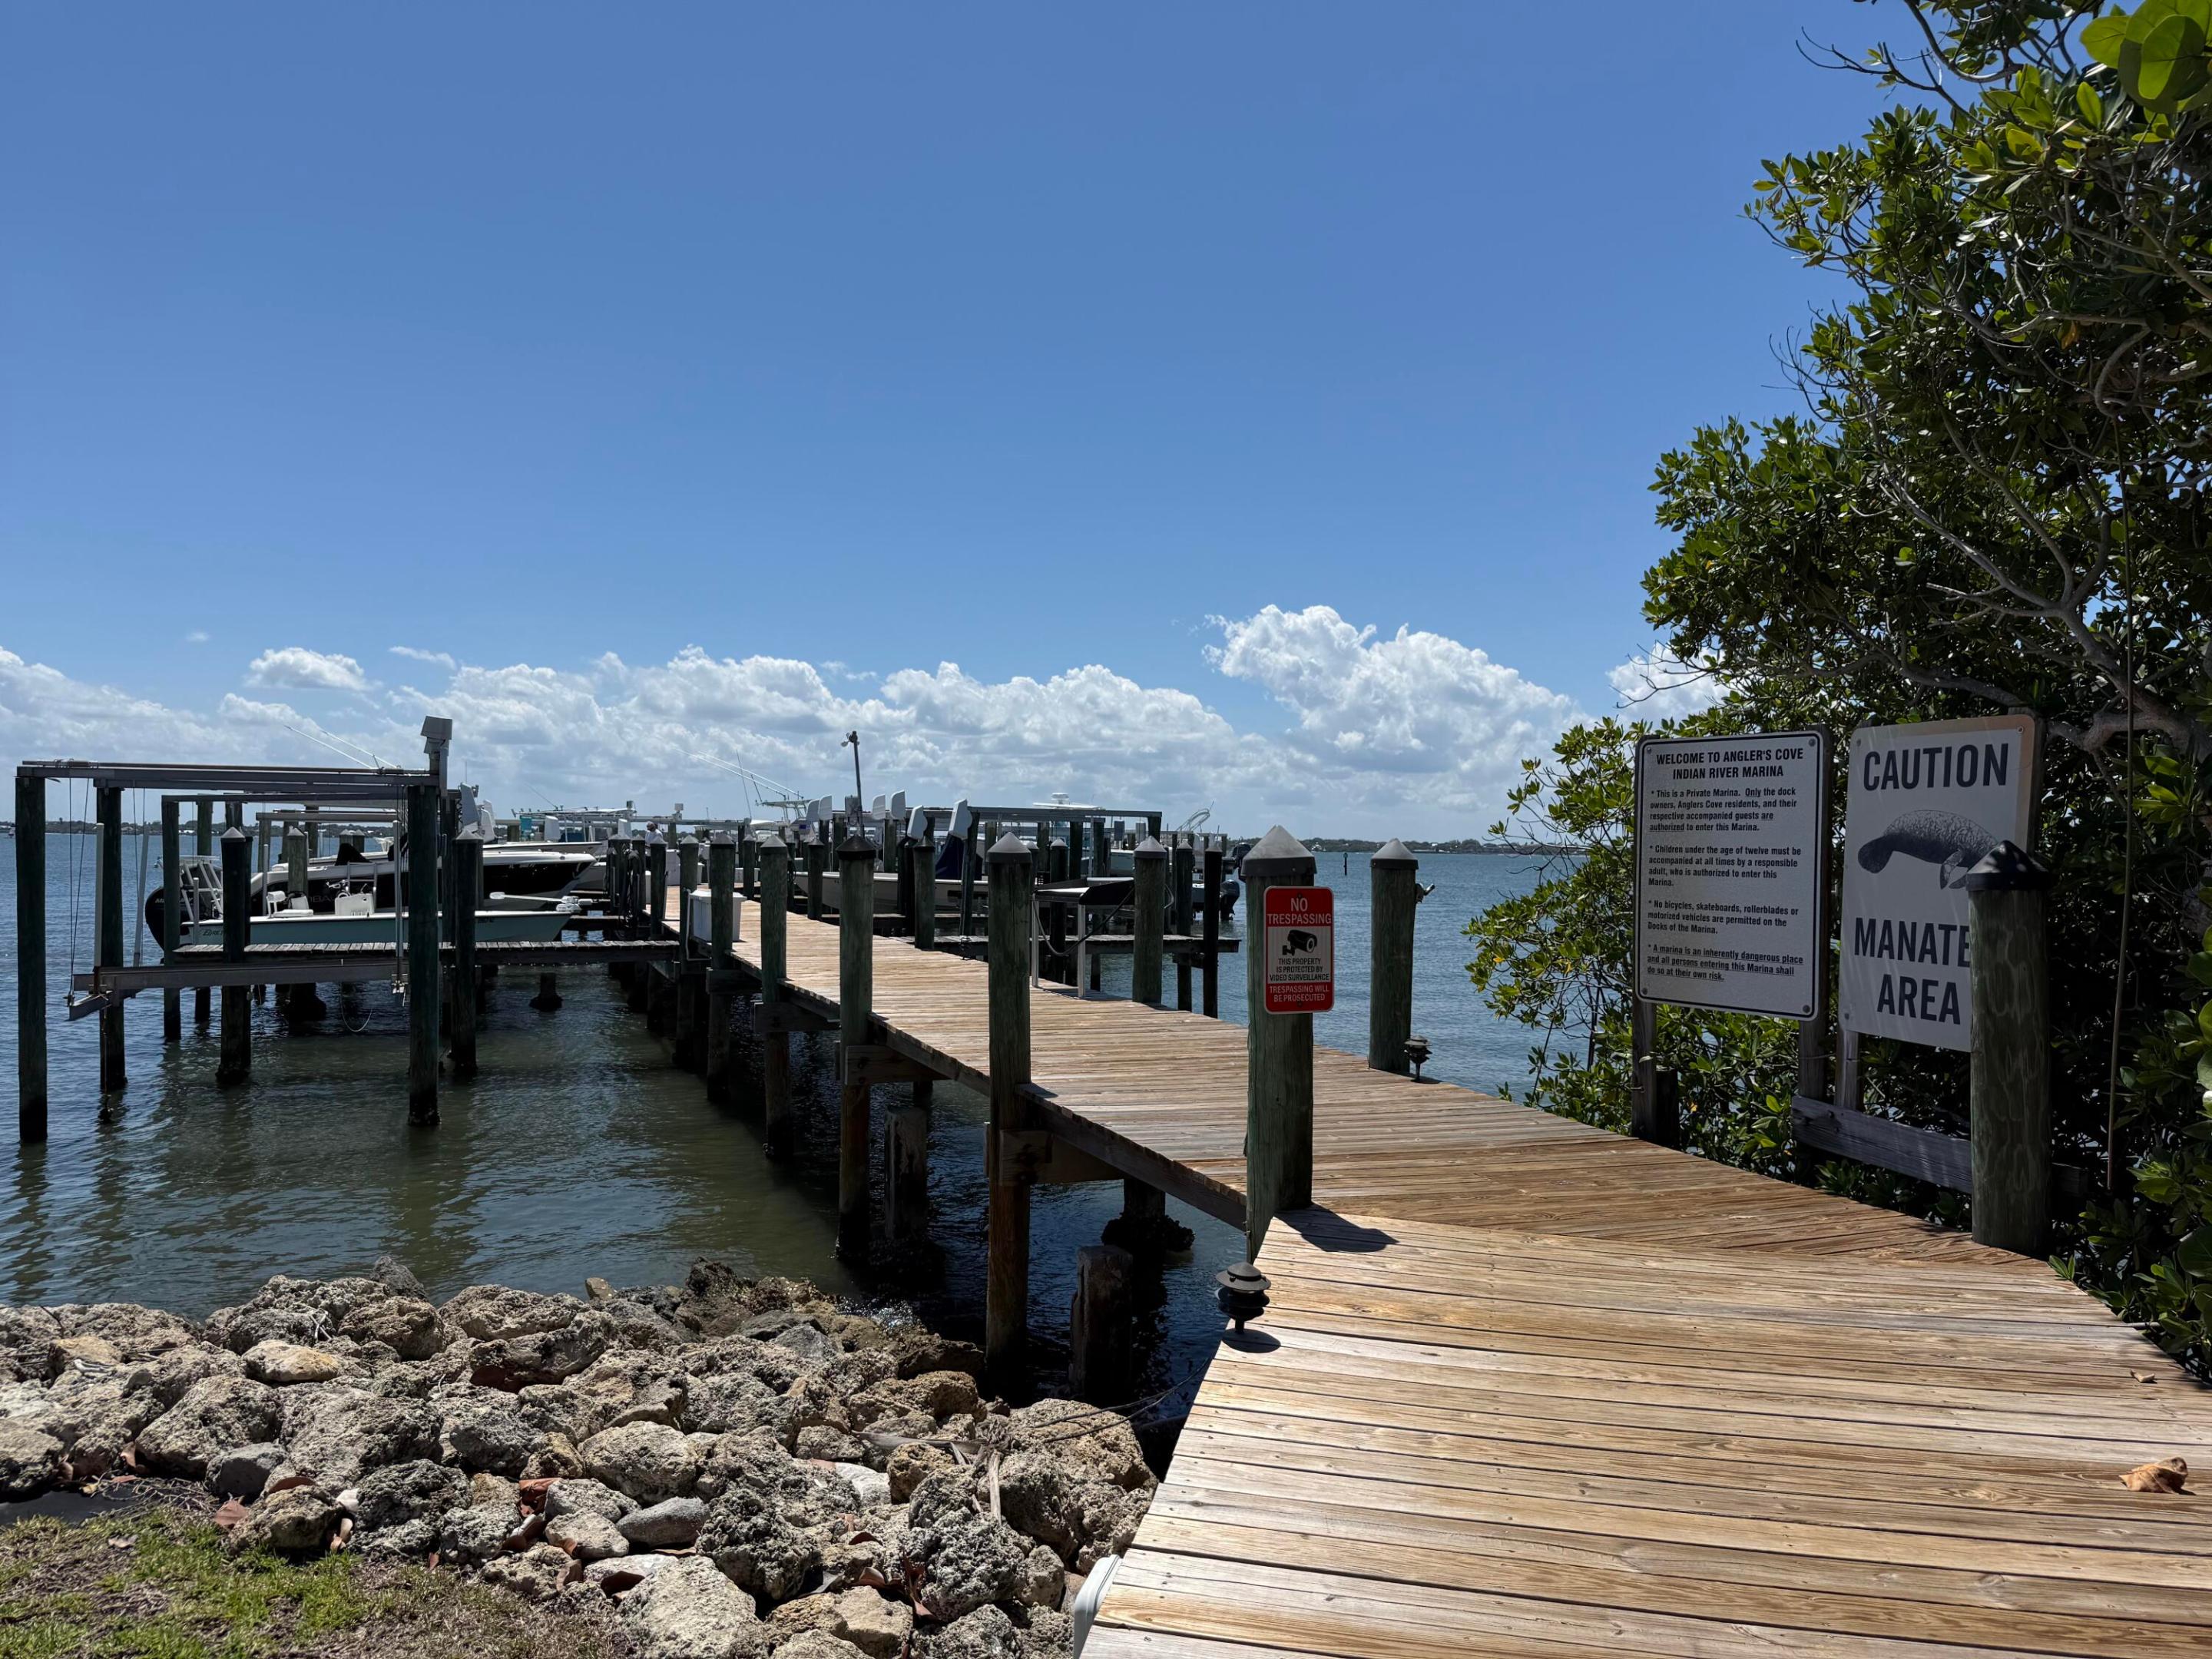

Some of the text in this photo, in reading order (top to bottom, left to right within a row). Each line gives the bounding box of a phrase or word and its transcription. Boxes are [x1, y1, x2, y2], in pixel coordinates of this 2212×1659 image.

[1657, 748, 1803, 764] WELCOME TO ANGLER'S COVE
[1673, 766, 1783, 780] INDIAN RIVER MARINA
[1864, 743, 2008, 791] CAUTION
[1745, 788, 1761, 798] Only
[1778, 787, 1795, 796] dock
[1678, 800, 1704, 810] Anglers
[1725, 800, 1760, 809] residents,
[1651, 812, 1684, 821] respective
[1686, 812, 1732, 821] accompanied
[1736, 812, 1759, 821] guests
[1650, 823, 1684, 832] authorized
[1655, 845, 1683, 853] Children
[1745, 846, 1769, 855] twelve
[1792, 847, 1801, 856] be
[1649, 857, 1693, 866] accompanied
[1737, 858, 1746, 868] by
[1754, 858, 1797, 868] responsible
[1693, 869, 1730, 877] authorized
[1649, 878, 1674, 886] Marina.
[1290, 897, 1308, 911] NO
[1664, 901, 1694, 911] bicycles,
[1697, 903, 1741, 912] skateboards,
[1744, 905, 1788, 914] rollerblades
[1267, 913, 1331, 925] TRESPASSING
[1682, 913, 1710, 922] vehicles
[1726, 916, 1761, 925] permitted
[1775, 918, 1786, 926] the
[1648, 922, 1667, 931] Docks
[1691, 926, 1717, 934] Marina.
[1854, 917, 1970, 969] MANATE
[1704, 949, 1739, 959] inherently
[1741, 952, 1780, 962] dangerous
[1783, 955, 1803, 964] place
[1672, 959, 1697, 967] persons
[1700, 960, 1729, 970] entering
[1732, 962, 1744, 971] this
[1747, 964, 1773, 972] Marina
[1776, 965, 1794, 975] shall
[1709, 972, 1724, 980] risk.
[1284, 993, 1325, 1002] PROSECUTED
[1876, 974, 1961, 1025] AREA
